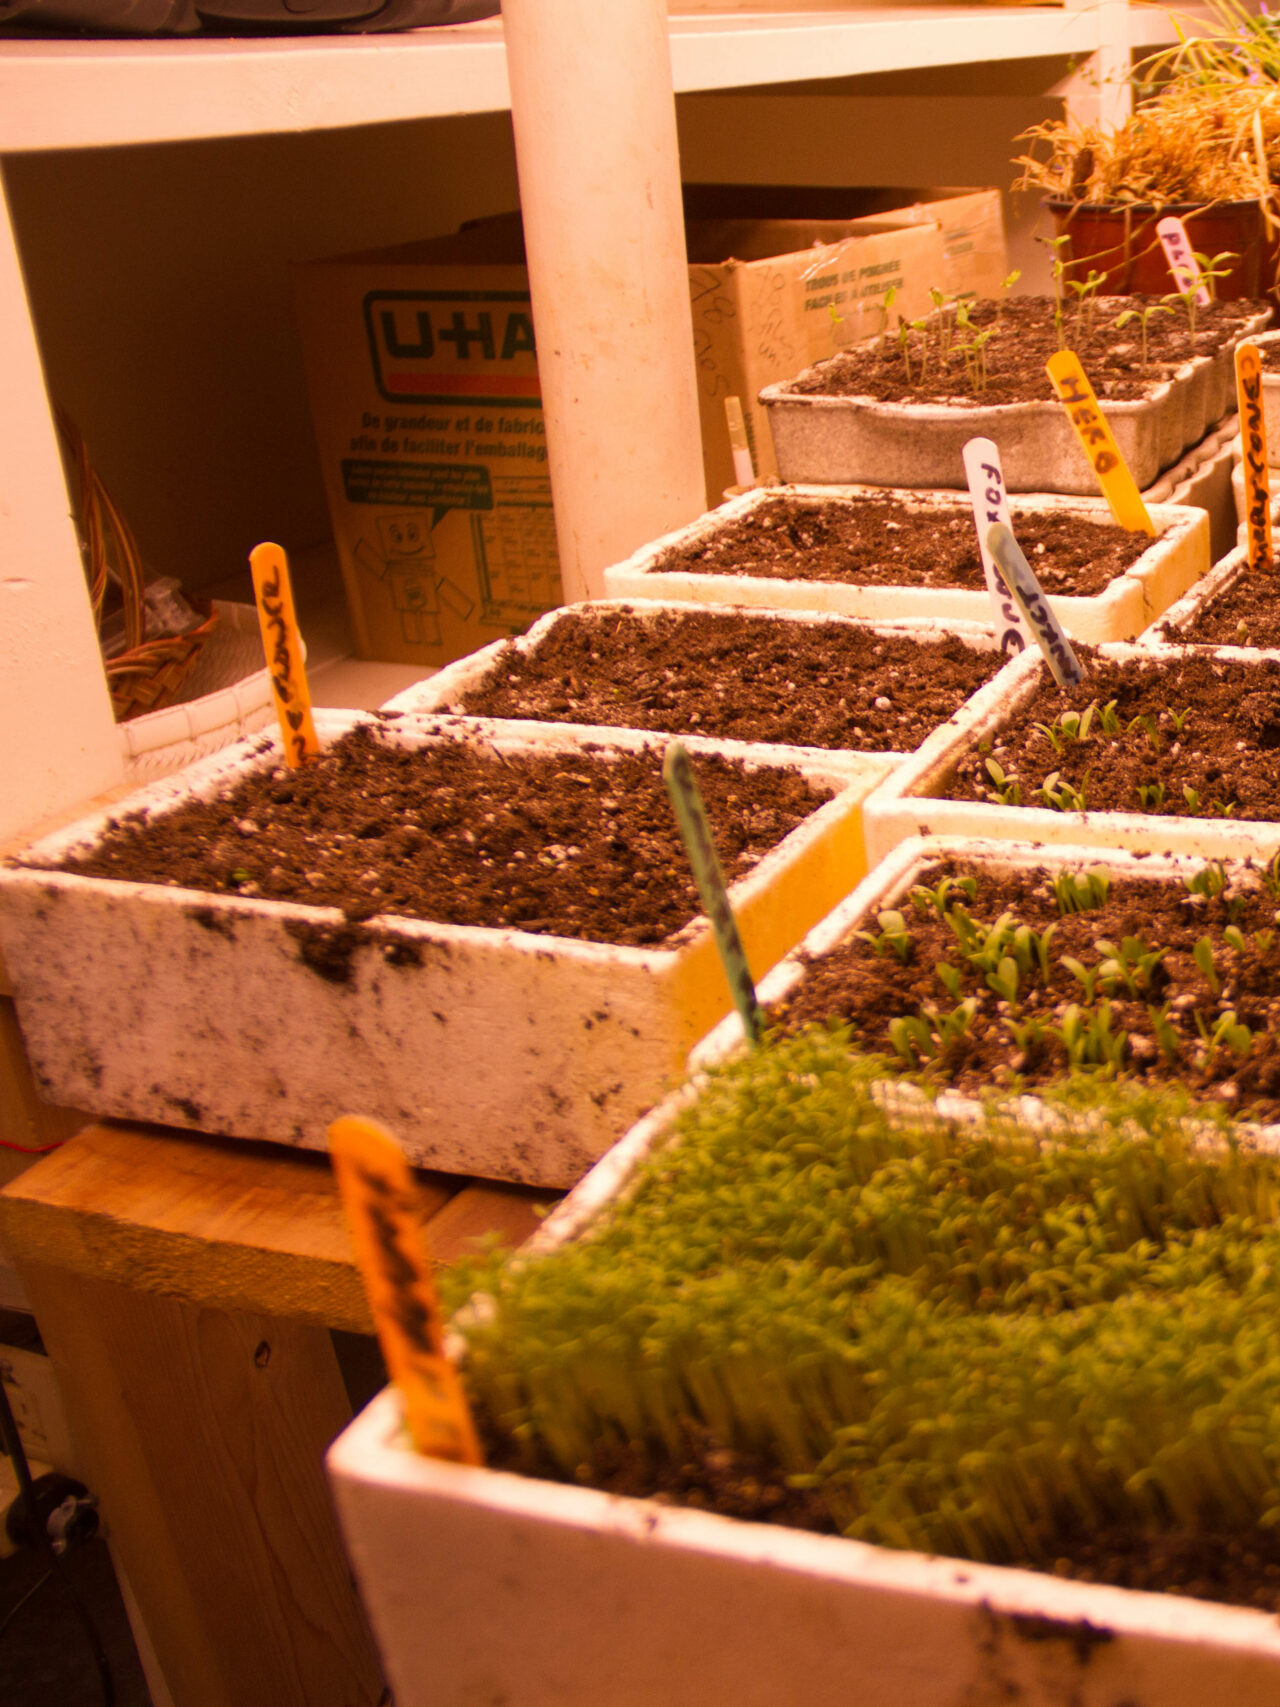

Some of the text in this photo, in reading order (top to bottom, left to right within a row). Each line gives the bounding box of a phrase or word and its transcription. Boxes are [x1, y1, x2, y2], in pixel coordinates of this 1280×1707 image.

[362, 412, 380, 429] De
[384, 413, 450, 433] grandeur
[456, 415, 470, 432] et
[475, 416, 493, 433] de
[1060, 377, 1119, 475] HERO
[349, 435, 377, 451] afin
[381, 436, 399, 452] de
[403, 437, 460, 454] faciliter
